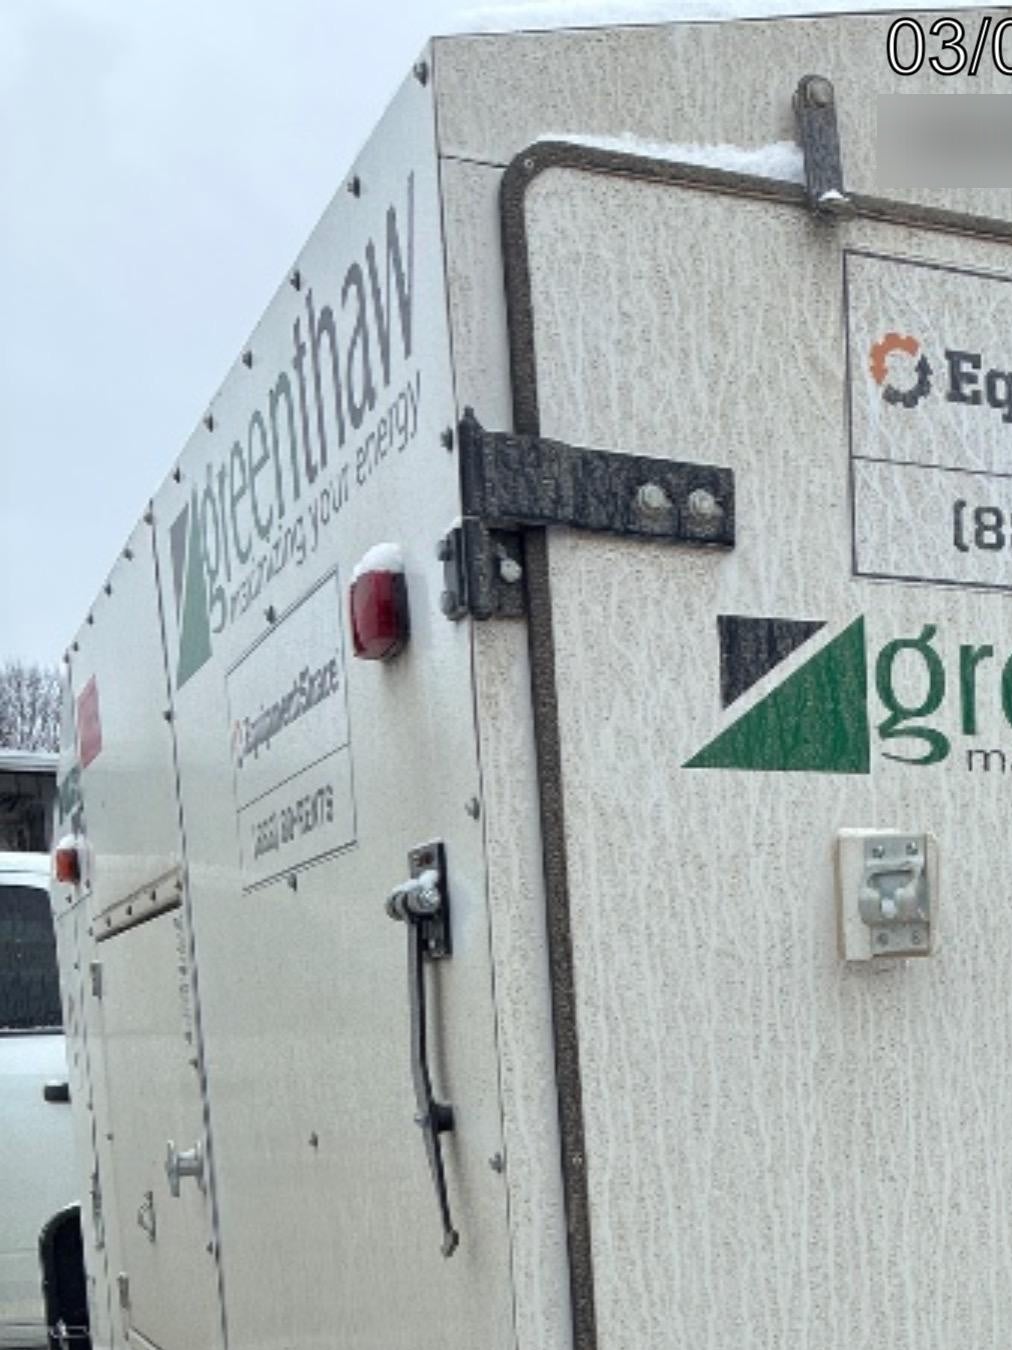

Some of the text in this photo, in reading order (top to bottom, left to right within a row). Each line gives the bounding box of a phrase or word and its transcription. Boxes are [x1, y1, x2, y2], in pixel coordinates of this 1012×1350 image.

[200, 169, 415, 634] greenthaw
[308, 459, 352, 553] your
[355, 370, 421, 488] energy
